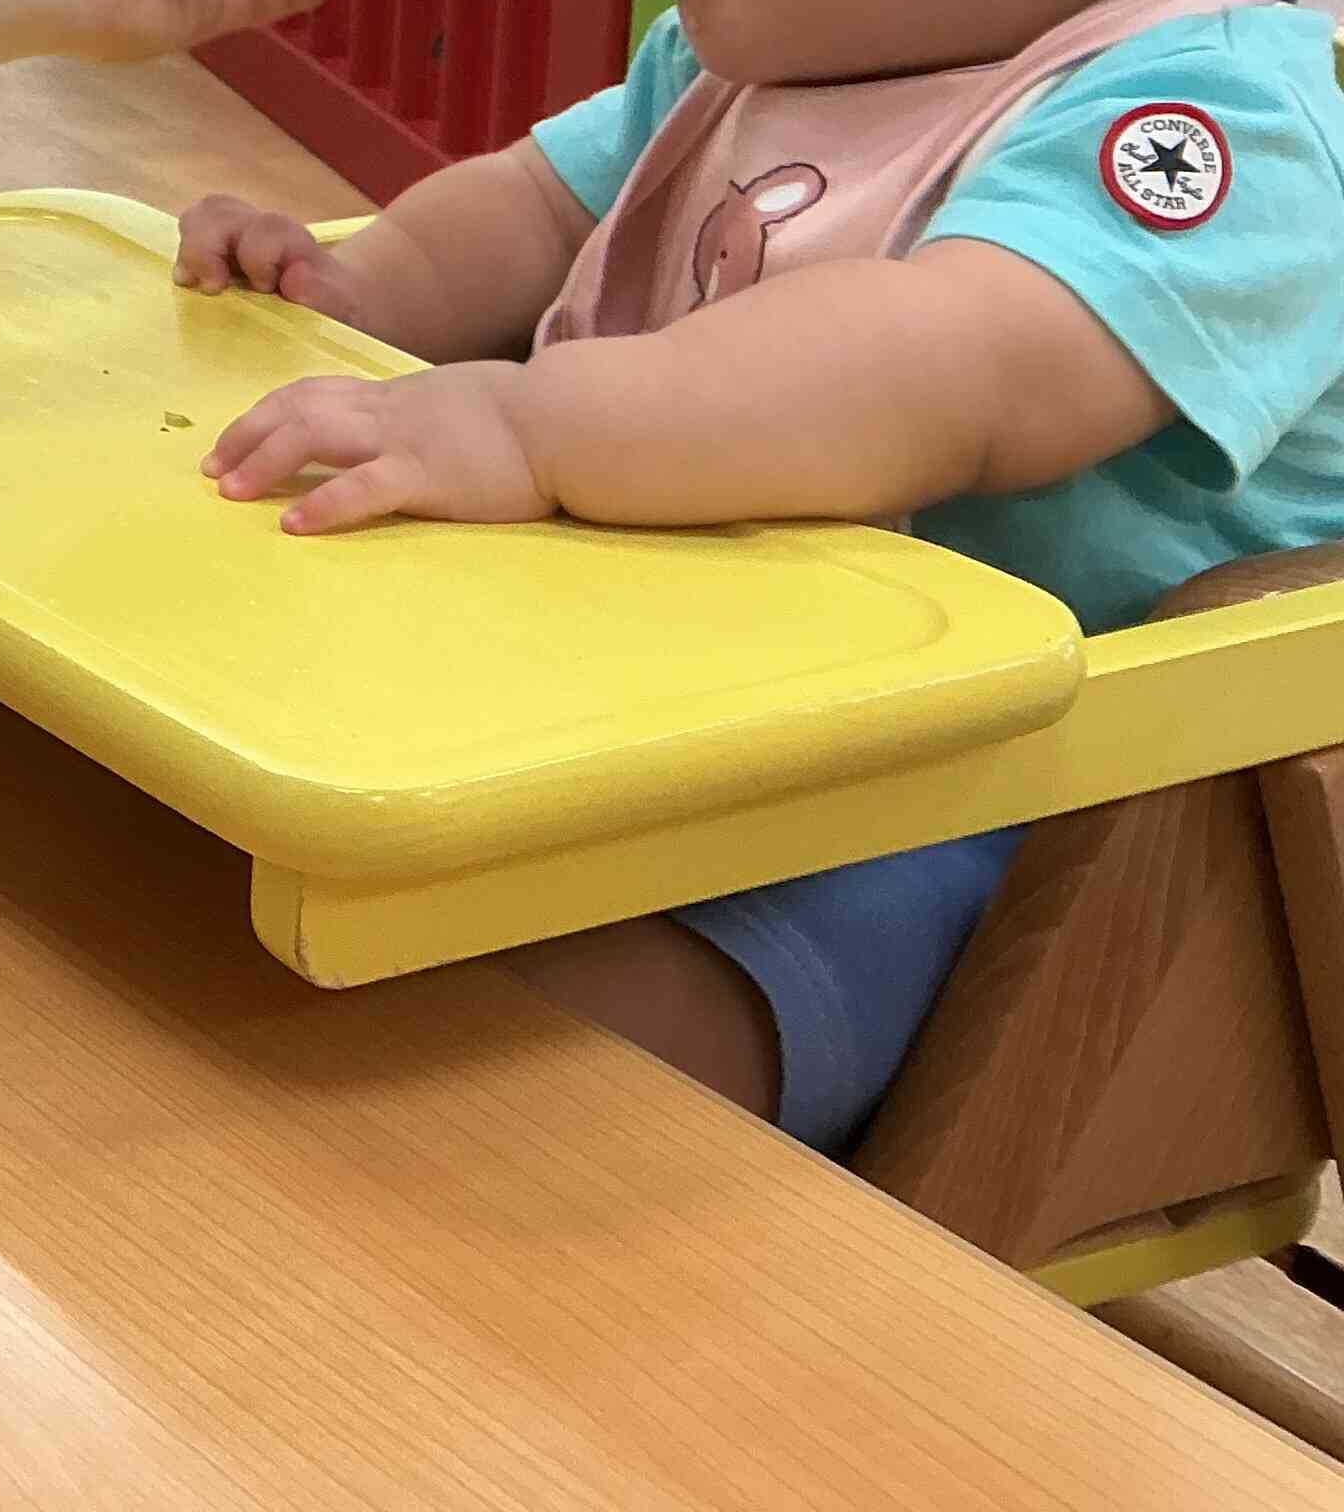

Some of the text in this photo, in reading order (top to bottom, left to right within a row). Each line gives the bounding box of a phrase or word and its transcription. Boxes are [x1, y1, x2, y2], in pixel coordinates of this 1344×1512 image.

[1140, 119, 1217, 174] CONVERSE
[1117, 162, 1140, 193] ALL
[1140, 188, 1187, 211] STAR
